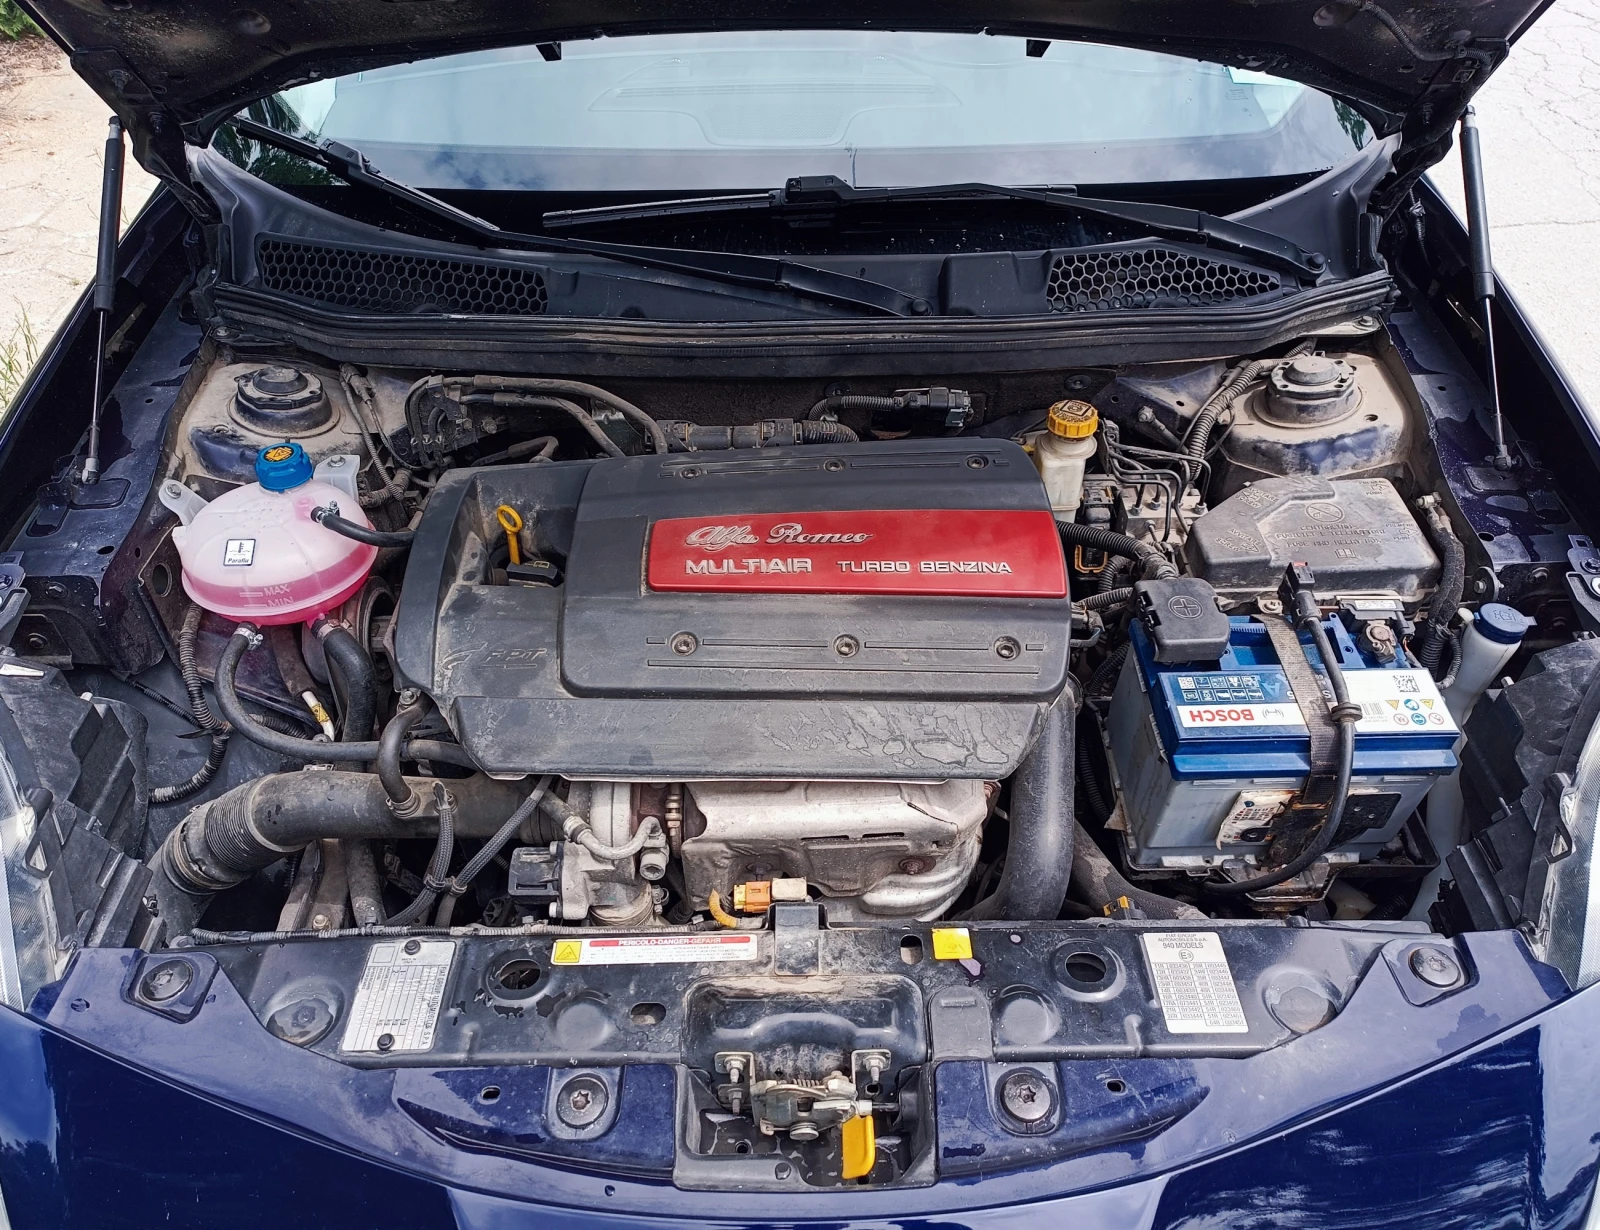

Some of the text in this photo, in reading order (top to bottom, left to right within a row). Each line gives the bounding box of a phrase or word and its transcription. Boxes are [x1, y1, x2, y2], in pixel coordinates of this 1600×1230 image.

[686, 523, 873, 553] Alfa Romeo
[1228, 528, 1261, 546] AVVITARE
[1215, 538, 1241, 552] SCREW
[685, 558, 812, 575] MULTIAIR
[836, 560, 1013, 574] TURBO BENZINA
[264, 584, 290, 597] MAX
[268, 596, 294, 608] MIN
[480, 648, 548, 663] FPT
[1190, 708, 1255, 723] BOSCH
[438, 966, 447, 976] FIAT
